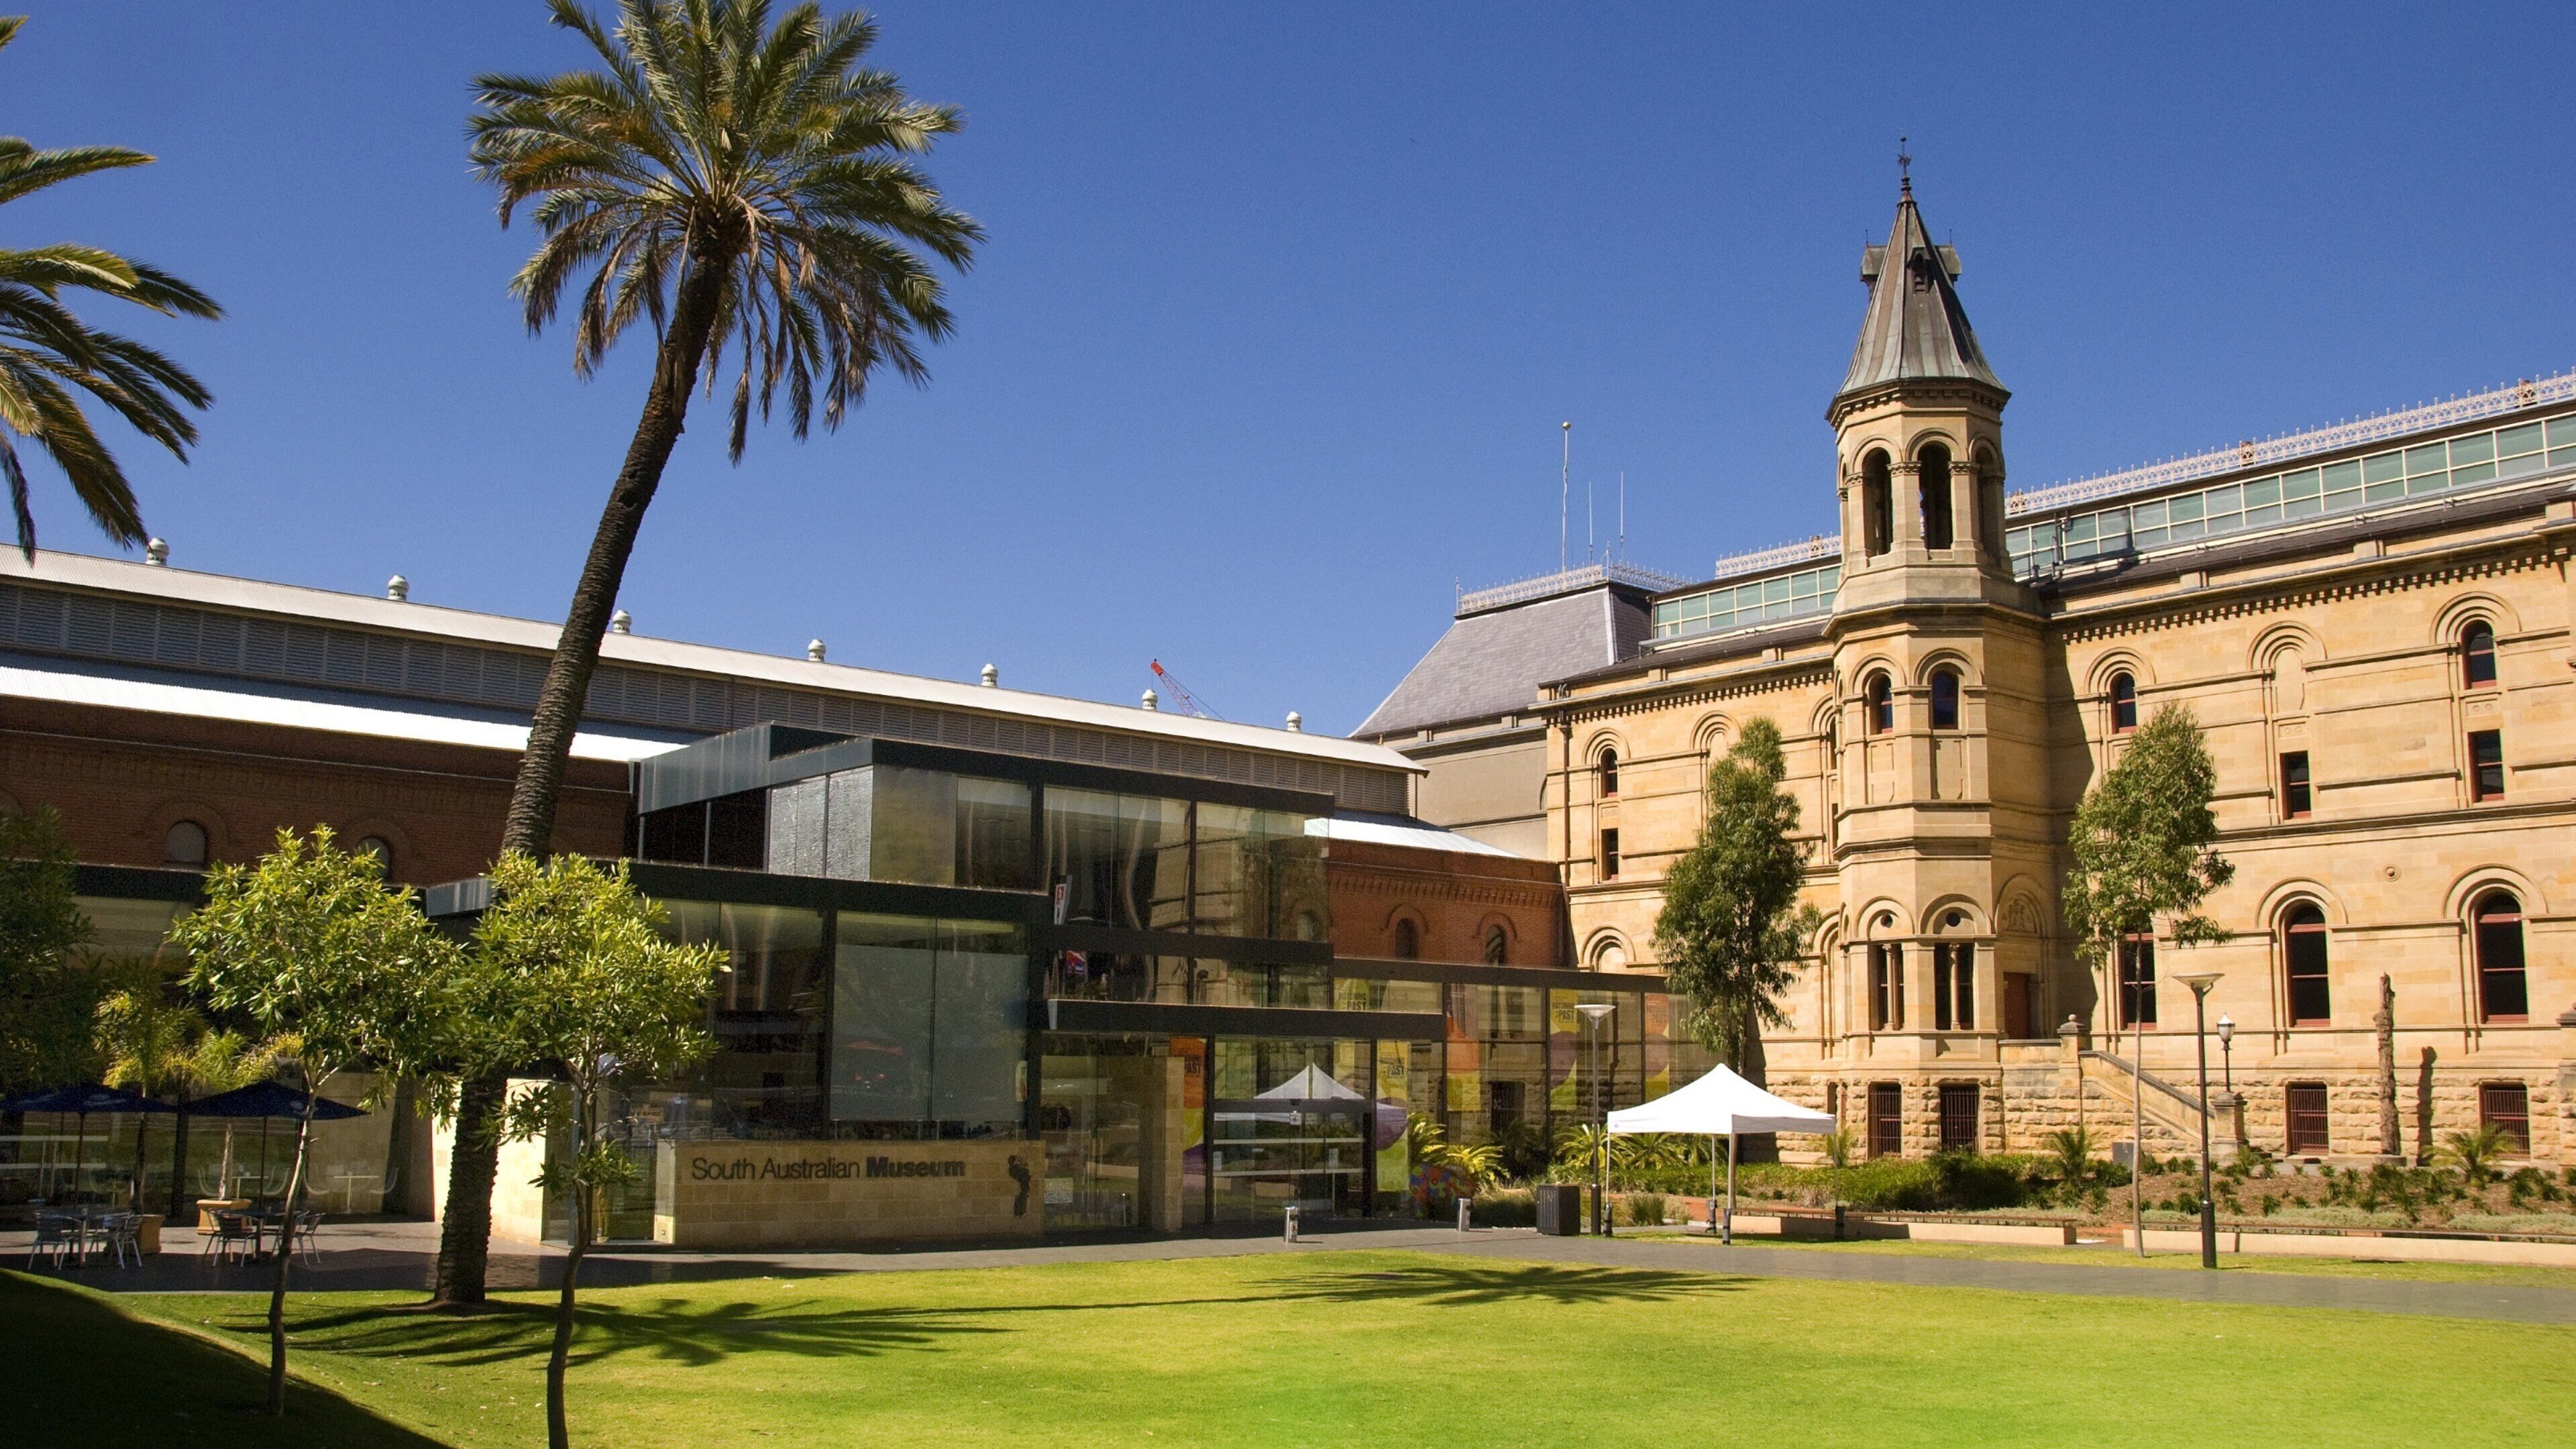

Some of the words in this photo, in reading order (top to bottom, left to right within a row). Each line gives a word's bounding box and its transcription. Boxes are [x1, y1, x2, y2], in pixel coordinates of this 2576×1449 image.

[1558, 1010, 1574, 1020] PAST
[692, 1157, 755, 1179] South
[760, 1157, 860, 1179] Australian
[866, 1156, 965, 1177] Museum
